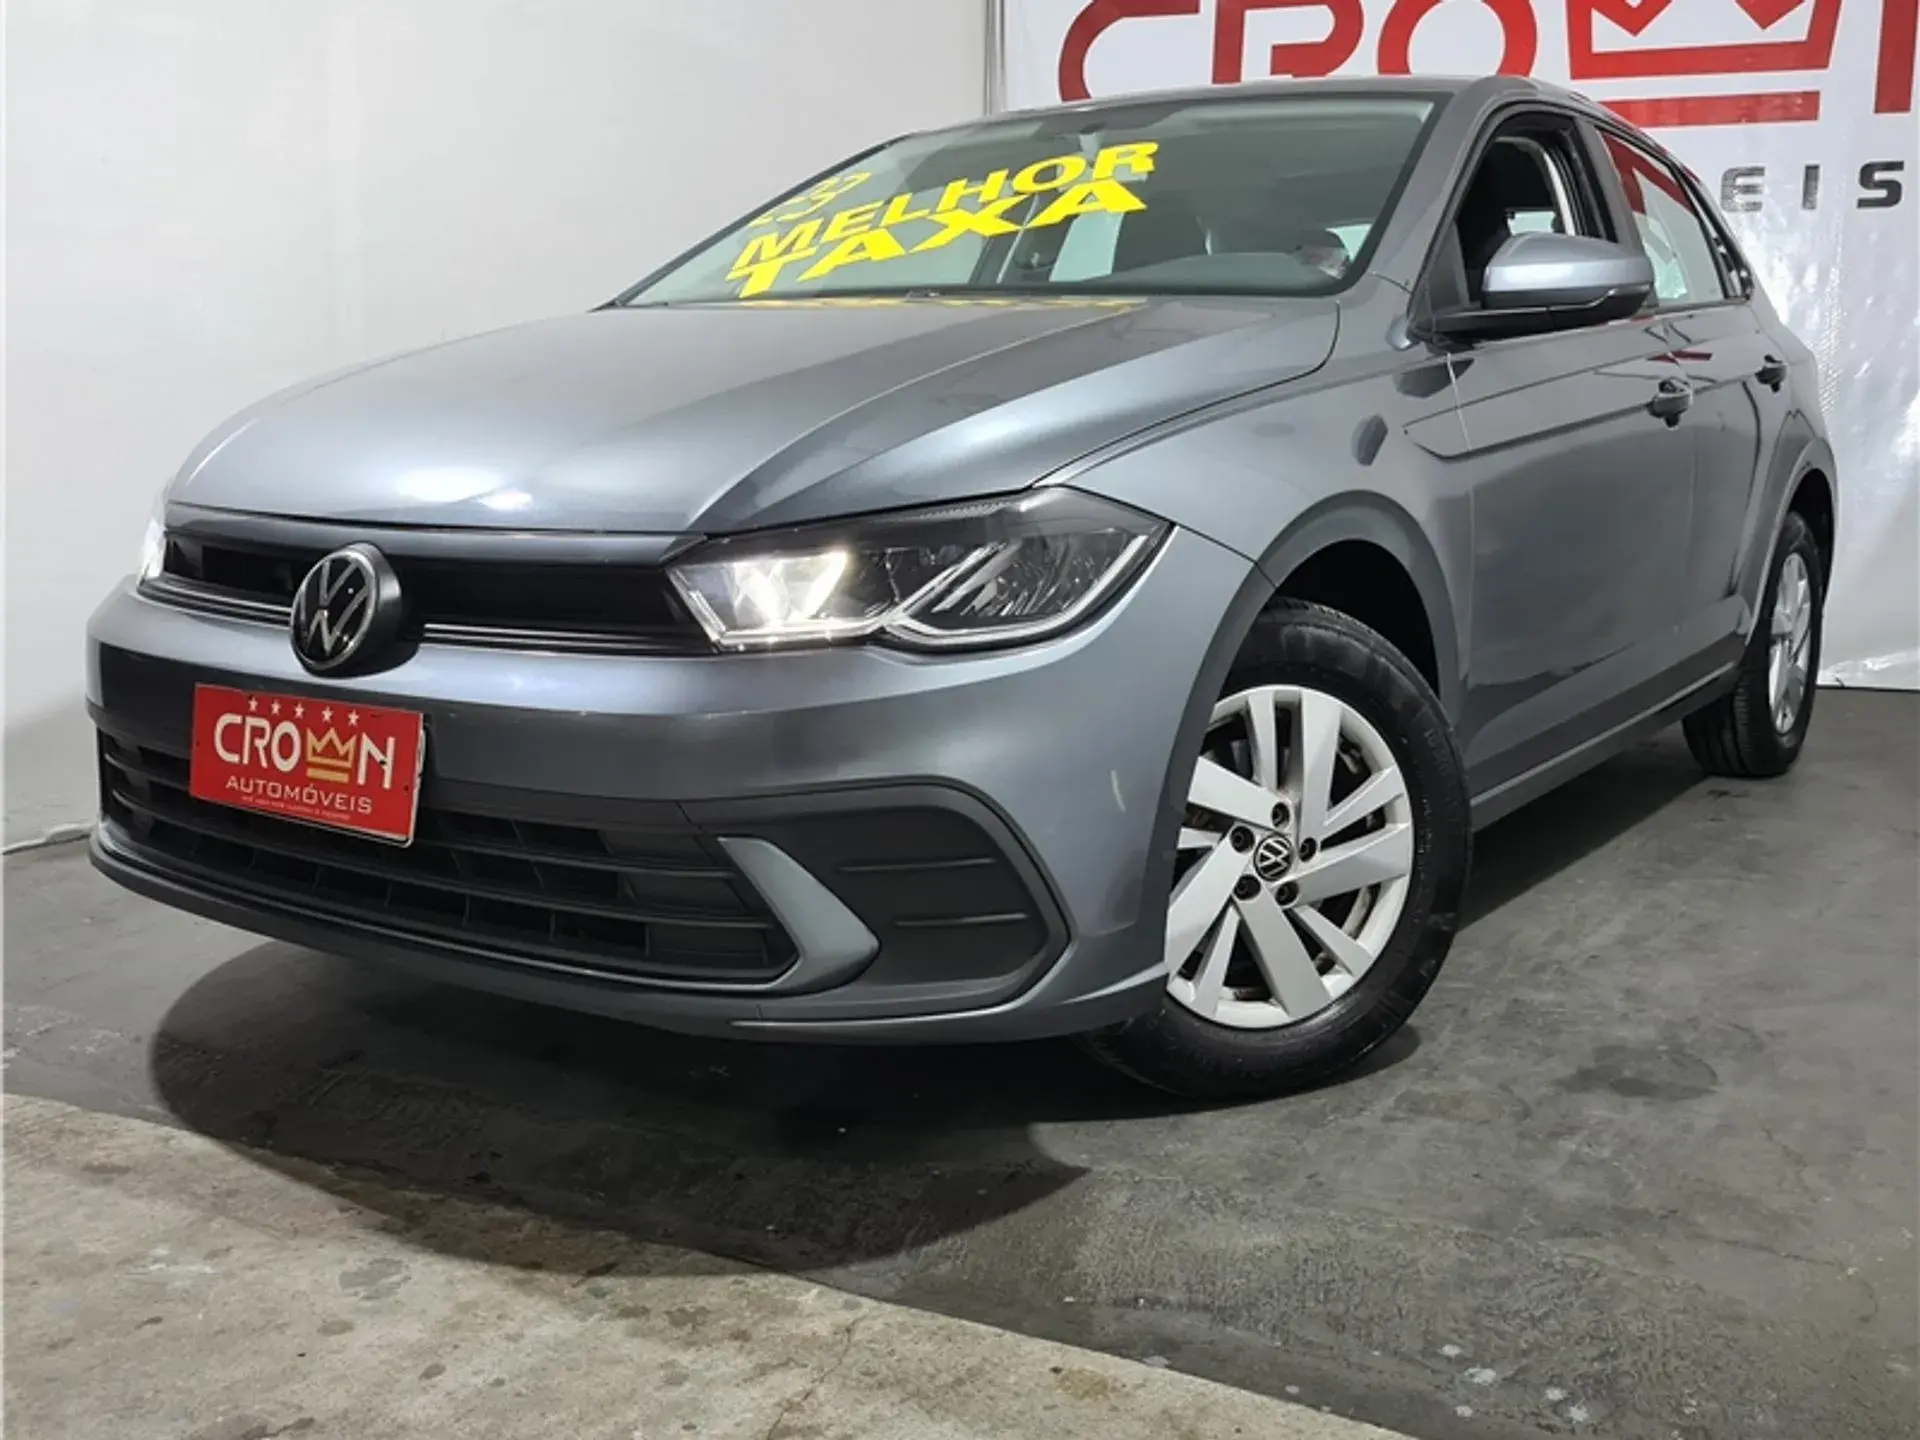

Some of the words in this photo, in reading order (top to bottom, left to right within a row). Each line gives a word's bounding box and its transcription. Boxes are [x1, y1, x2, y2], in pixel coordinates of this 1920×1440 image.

[724, 179, 1148, 298] TAXA
[732, 141, 1159, 272] MELHOR
[225, 775, 373, 815] AUTOMÓVEIS
